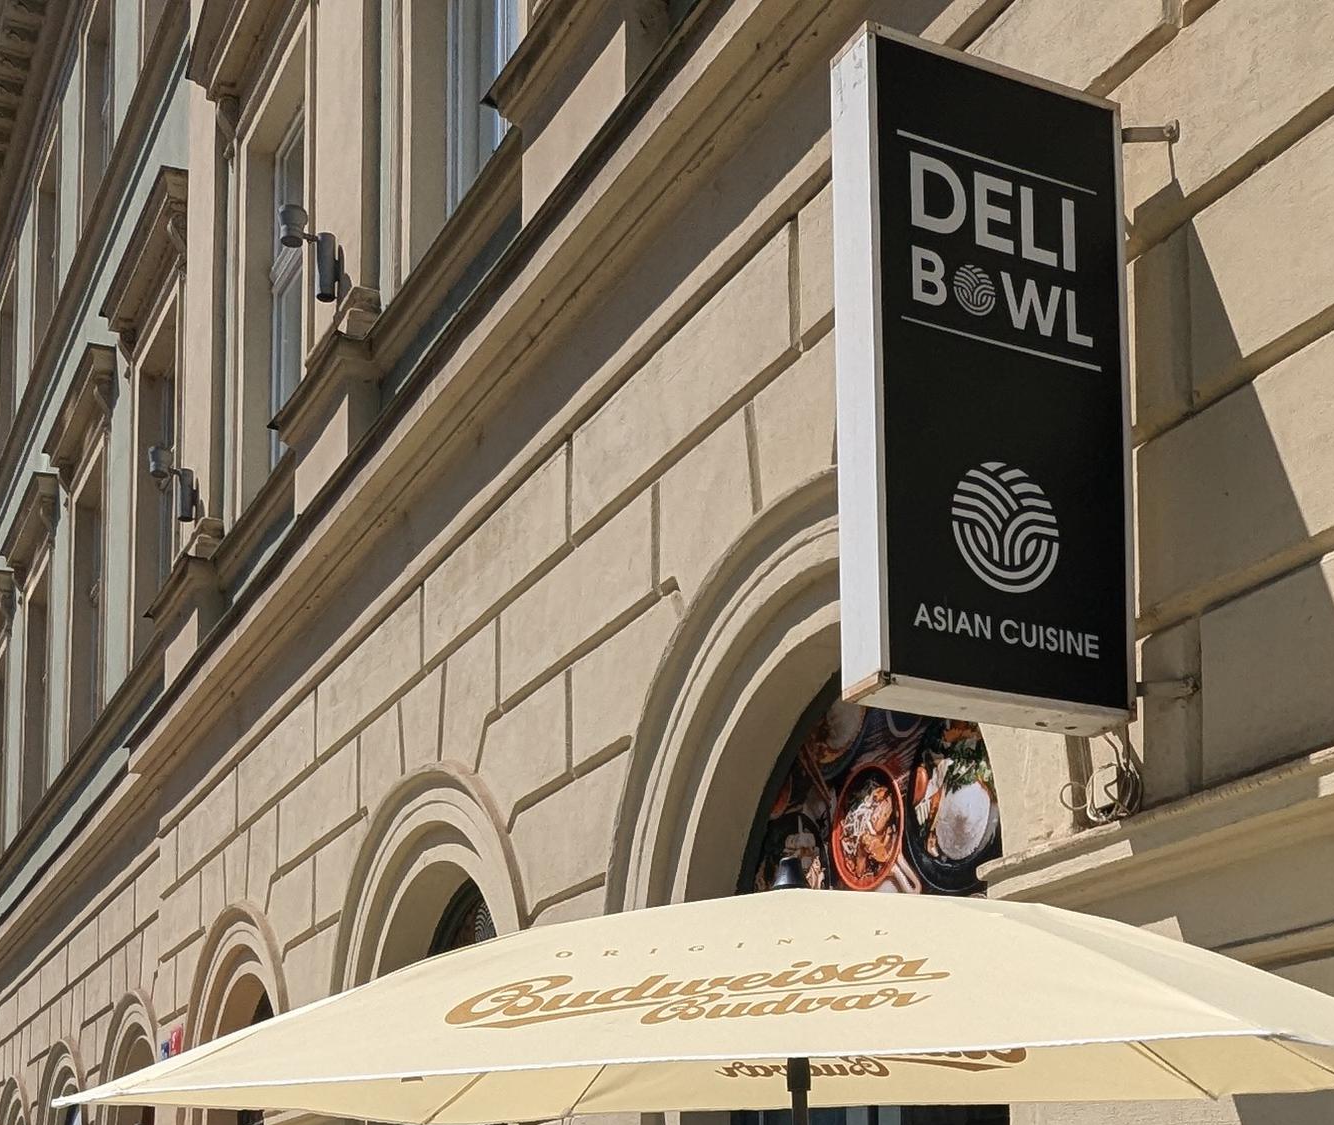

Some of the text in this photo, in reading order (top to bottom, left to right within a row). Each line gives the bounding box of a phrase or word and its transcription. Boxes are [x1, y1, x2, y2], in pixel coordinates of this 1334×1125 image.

[909, 150, 1077, 273] DELI
[913, 602, 1101, 660] ASIAN CUISINE
[554, 929, 889, 958] ORIGINAL
[444, 954, 951, 1029] Budweiser
[640, 987, 932, 1025] Budvar
